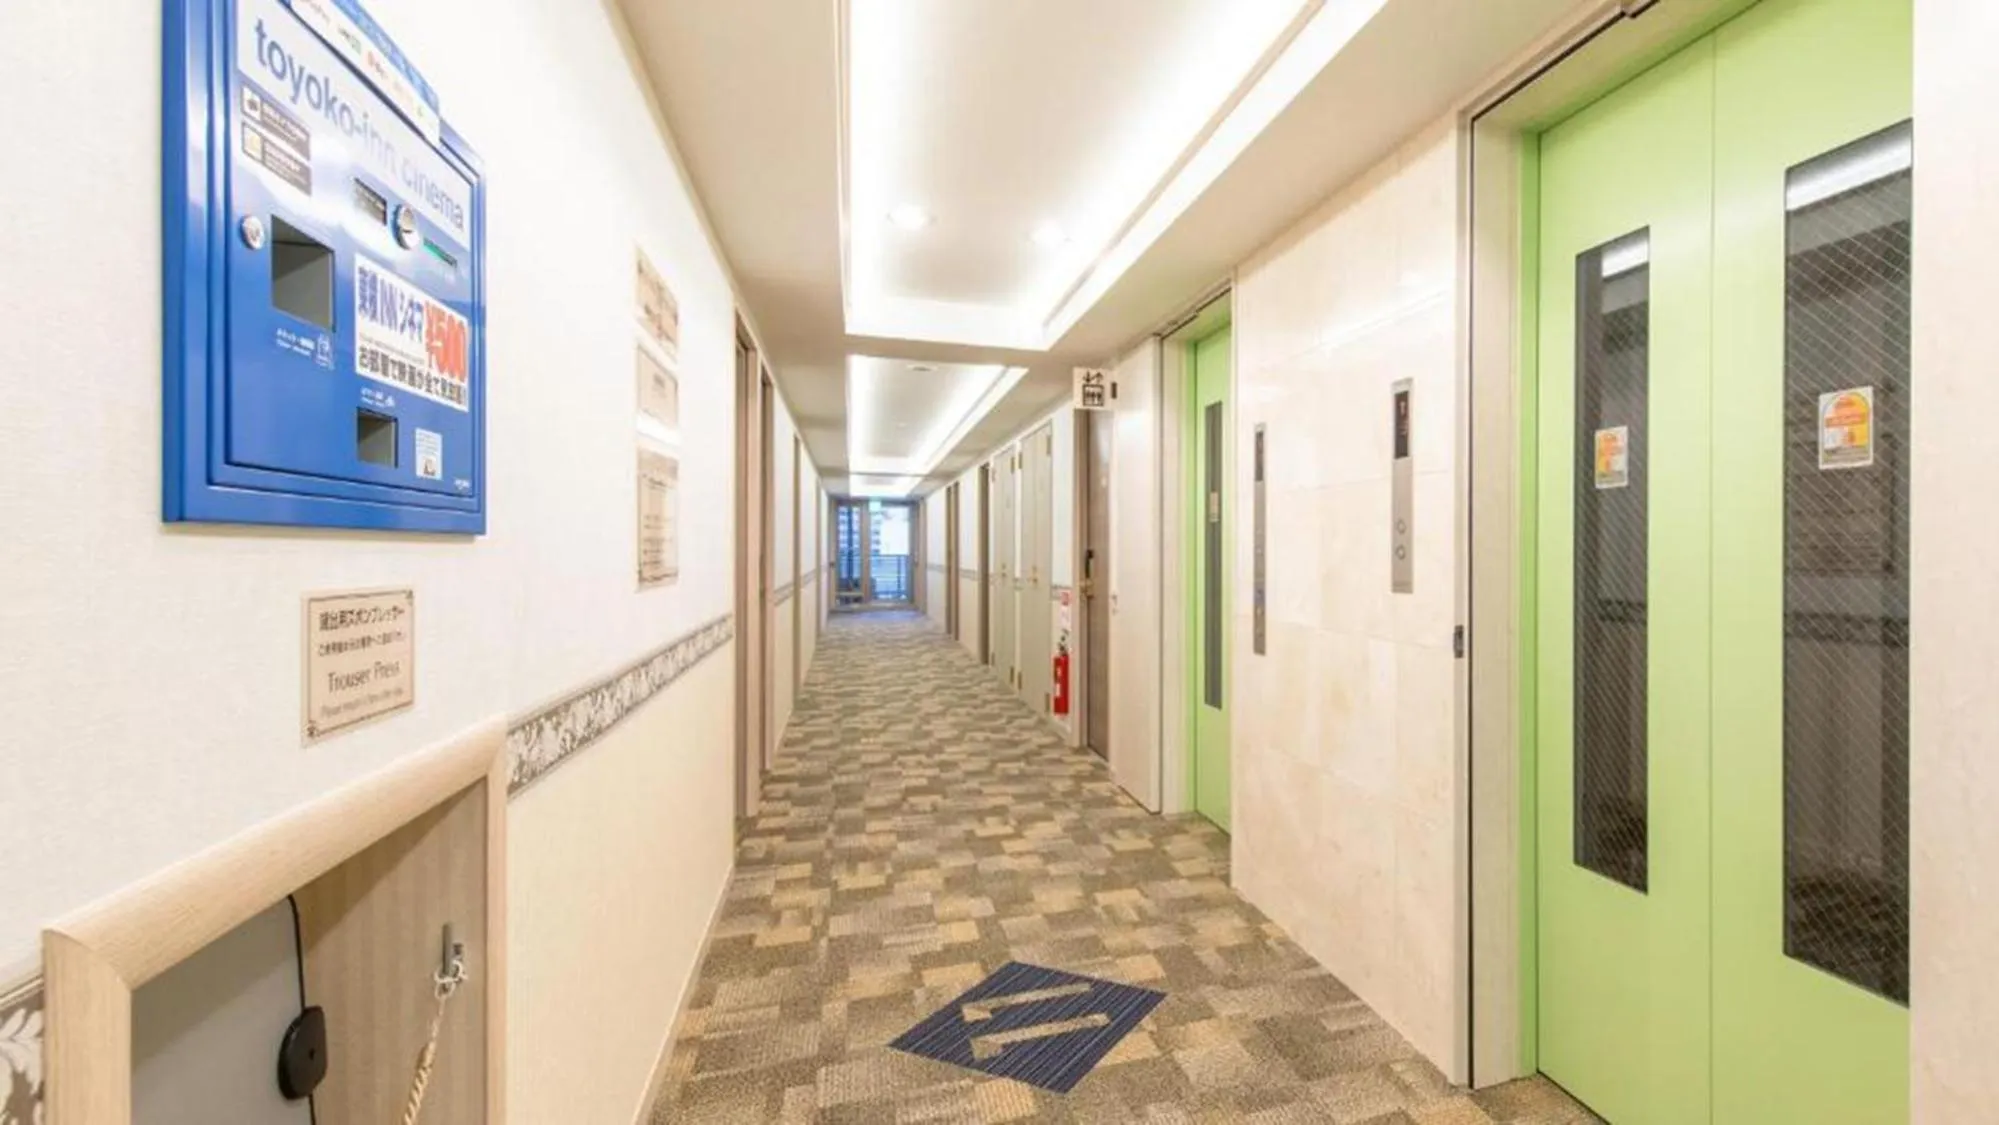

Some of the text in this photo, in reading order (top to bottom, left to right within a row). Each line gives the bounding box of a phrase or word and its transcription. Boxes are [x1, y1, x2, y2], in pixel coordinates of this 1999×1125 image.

[255, 18, 398, 176] toyoko-inn
[403, 156, 463, 230] cinema
[328, 670, 370, 692] Trouser
